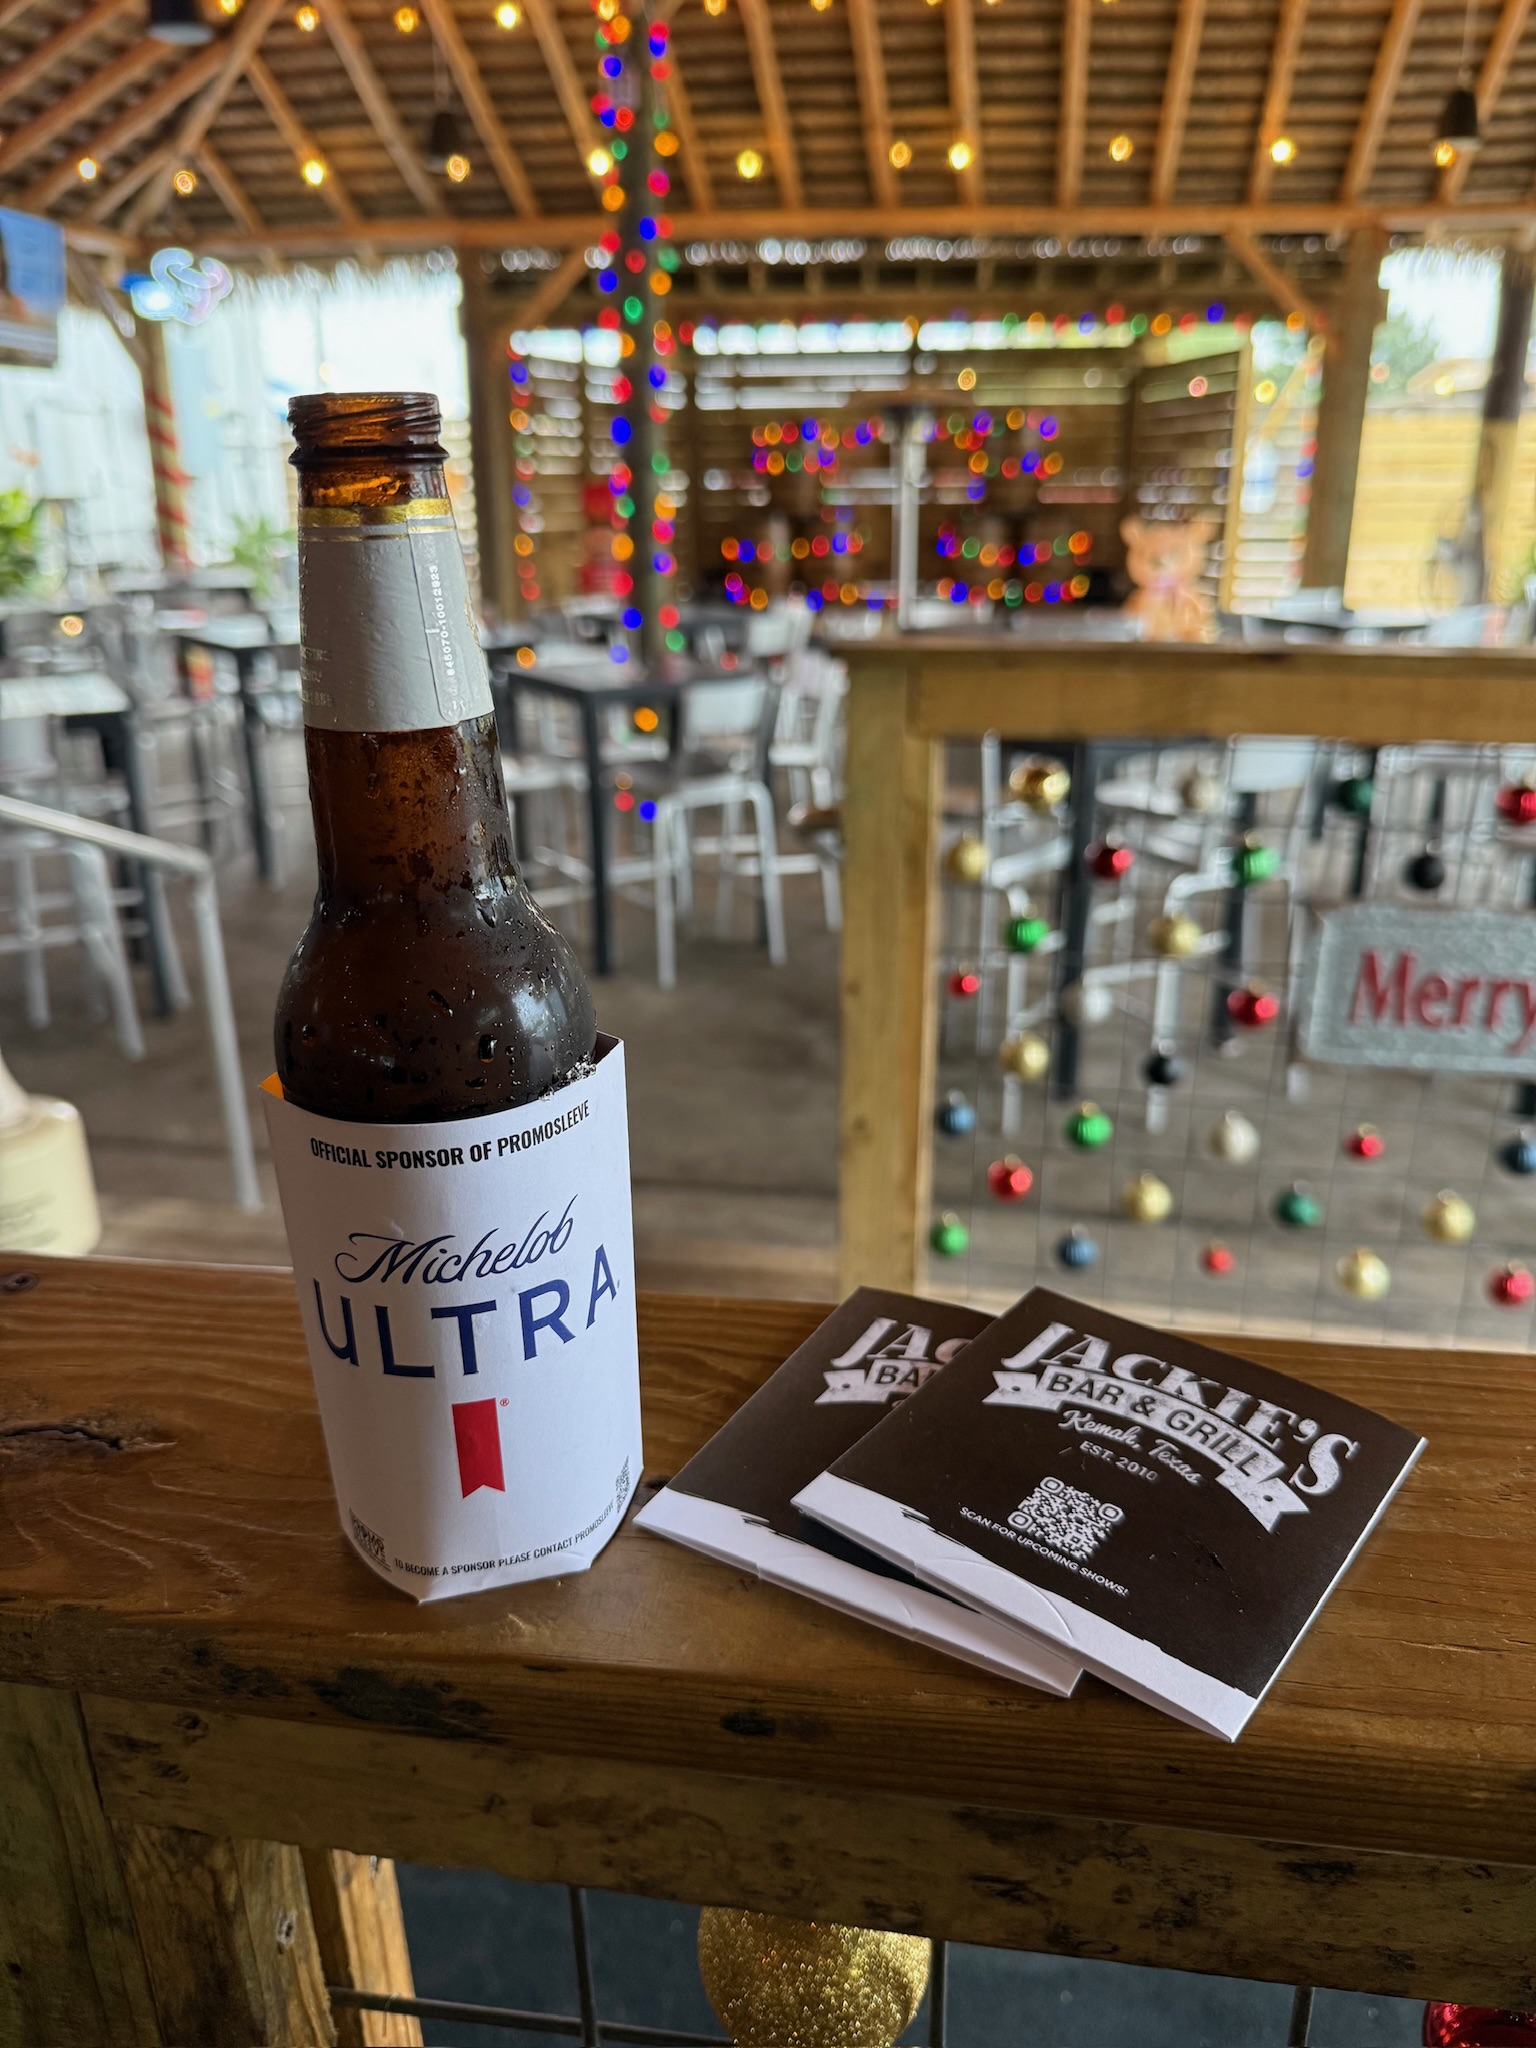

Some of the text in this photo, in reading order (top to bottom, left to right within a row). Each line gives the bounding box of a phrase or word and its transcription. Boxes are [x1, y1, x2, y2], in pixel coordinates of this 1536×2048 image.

[1349, 948, 1536, 1057] Merry
[310, 1100, 590, 1169] OFFICIAL SPONSOR OF PROMOSLEEVE
[335, 1194, 579, 1285] Michelob
[313, 1243, 618, 1379] ULTRA
[1001, 1322, 1360, 1497] JACKIE'S
[1046, 1372, 1261, 1478] BAR & GRILL
[1058, 1409, 1202, 1484] Kemah, Texas
[1079, 1440, 1112, 1462] EST.
[405, 1562, 440, 1576] BECOME
[442, 1566, 450, 1576] A
[451, 1560, 496, 1575] SPONSOR
[498, 1550, 532, 1568] PLEASE
[533, 1537, 574, 1559] CONTACT
[960, 1506, 1129, 1597] SCAN FOR UPCOMING SHOWS!
